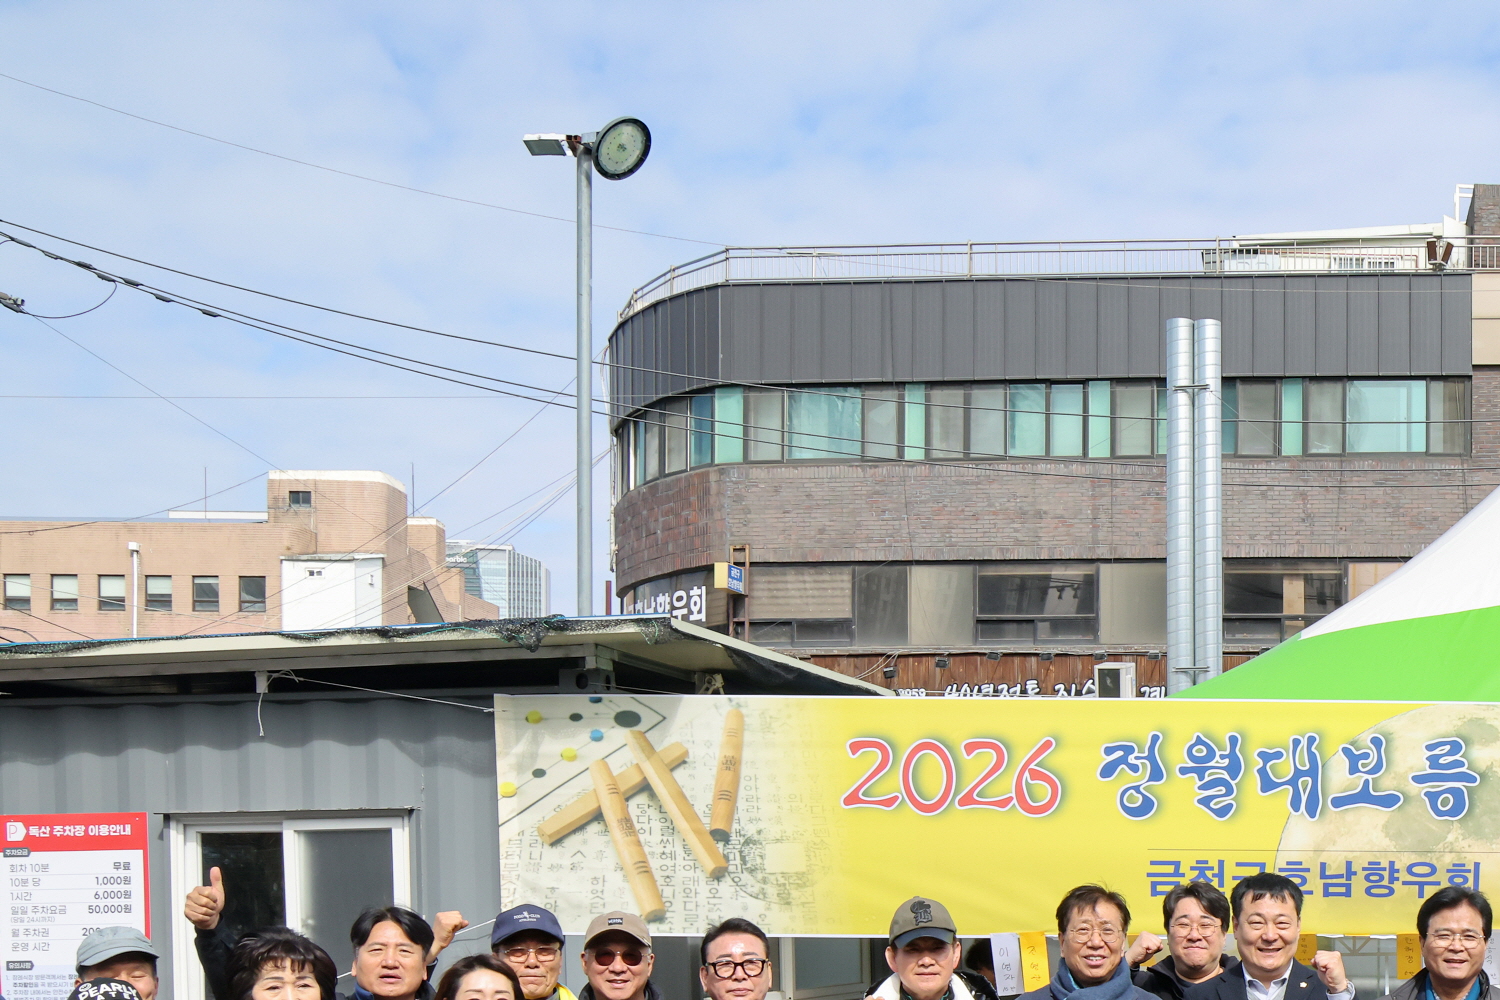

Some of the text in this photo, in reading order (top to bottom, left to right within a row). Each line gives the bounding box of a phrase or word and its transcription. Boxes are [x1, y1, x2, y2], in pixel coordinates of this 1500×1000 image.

[841, 735, 1063, 818] 2026
[1097, 731, 1480, 822] 정월대보름
[29, 824, 131, 837] 독산 주차장 이용안내
[9, 861, 131, 873] 회차 10분 무료
[9, 876, 132, 888] 10분 당 1,000원
[10, 890, 132, 901] 1시간 6,000원
[10, 904, 132, 916] 일일 주차요금 50,000원
[22, 928, 49, 938] 주차권
[11, 942, 50, 952] 운영 시간
